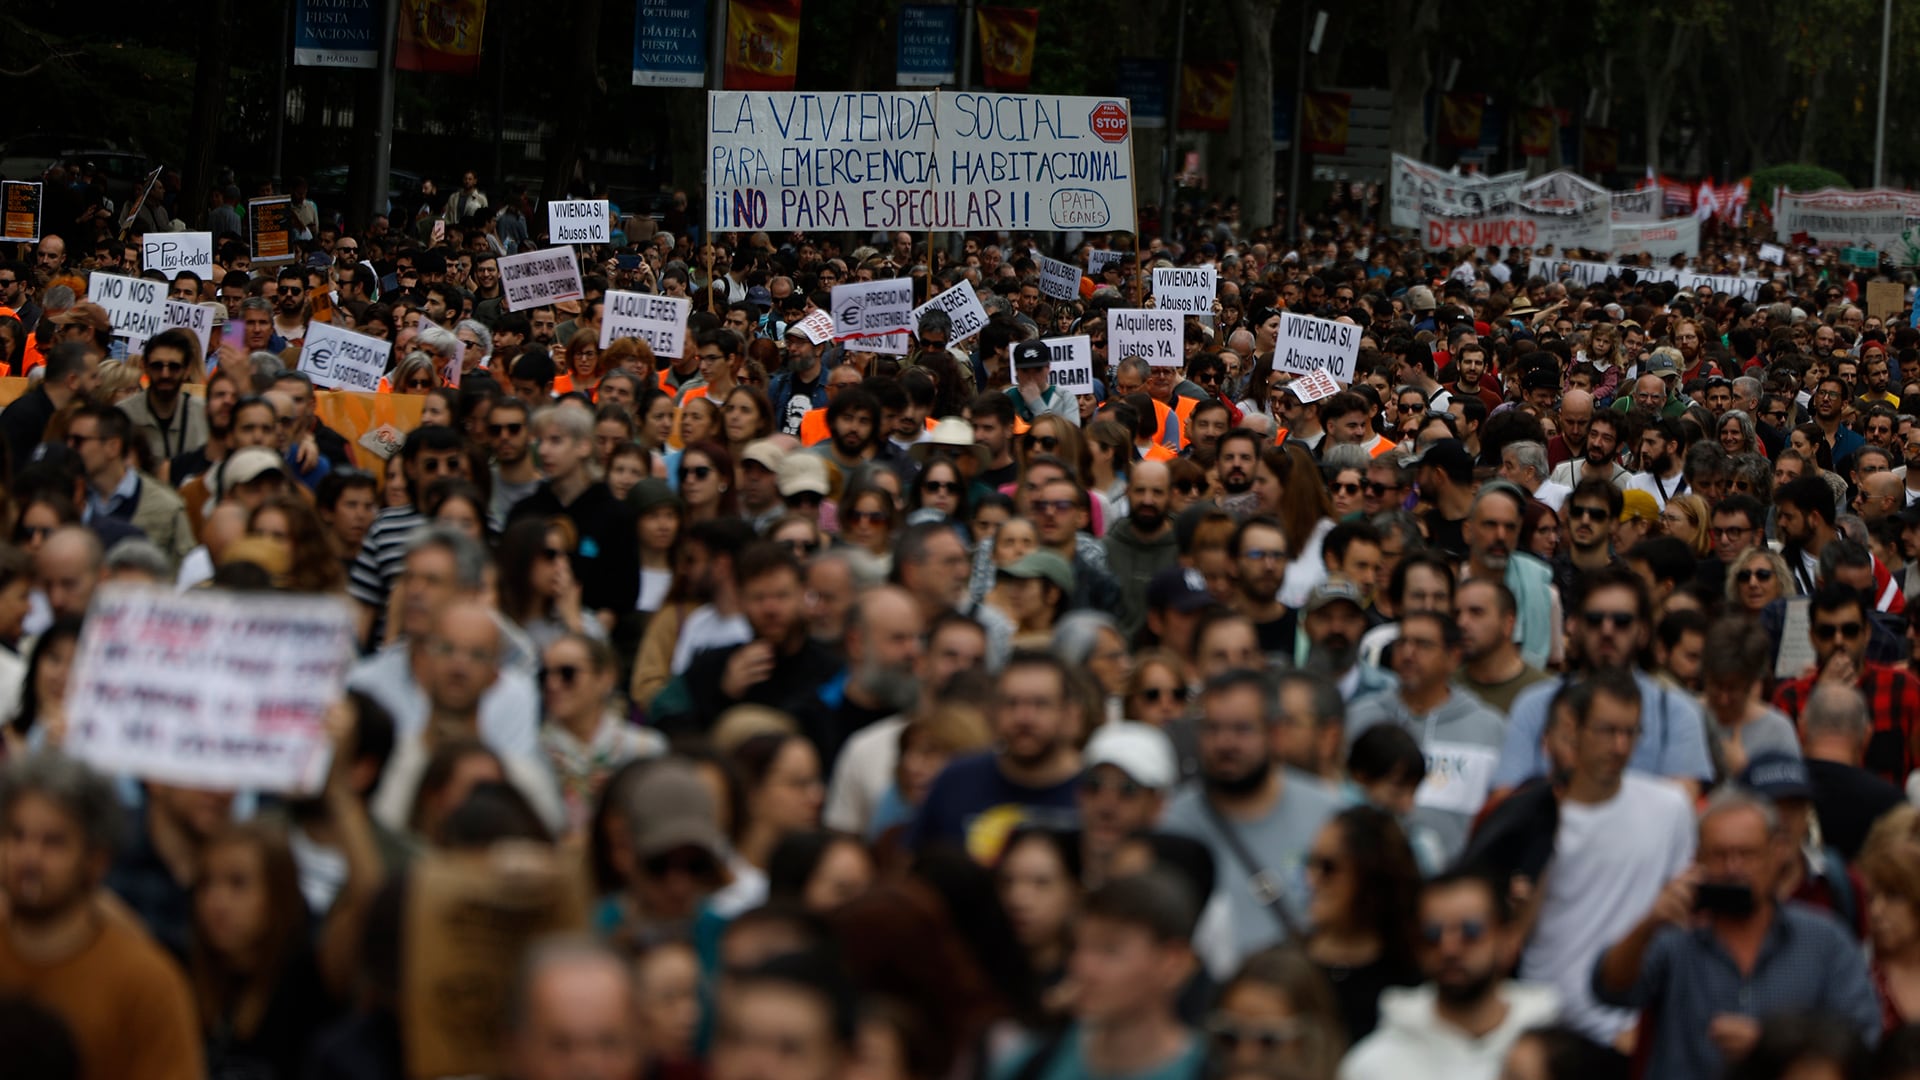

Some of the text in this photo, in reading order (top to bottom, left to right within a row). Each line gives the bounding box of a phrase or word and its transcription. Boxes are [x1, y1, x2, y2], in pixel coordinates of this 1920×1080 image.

[306, 11, 350, 24] FIESTA
[665, 27, 680, 38] DE
[642, 39, 679, 51] FIESTA
[642, 53, 701, 65] NACIONAL
[712, 93, 755, 135] LA
[768, 92, 940, 143] VIVIENDA
[1096, 117, 1127, 129] STOP
[712, 145, 1128, 187] PARA EMERGENCIA HABITACIONAL
[781, 189, 849, 228] PARA
[1062, 192, 1096, 209] PAH
[554, 203, 592, 218] VIVIENDA
[1053, 209, 1106, 225] LEGANES
[558, 224, 604, 240] Abusos NO.
[1429, 219, 1537, 249] DESAHUCIO
[503, 262, 539, 281] OCUPAMOS
[537, 258, 557, 276] PARA
[1158, 271, 1199, 288] VIVIENDA
[128, 281, 155, 304] NOS
[530, 282, 551, 299] PARA
[865, 288, 912, 307] PRECIO NO
[1160, 294, 1209, 312] Abusos NO.
[864, 311, 912, 330] SOSTENIBLE
[1115, 314, 1176, 336] Alquileres,
[1287, 317, 1337, 346] VIVIENDA
[339, 340, 386, 369] PRECIO NO
[1118, 339, 1176, 361] justos YA.
[332, 363, 381, 392] SOSTENIBLE
